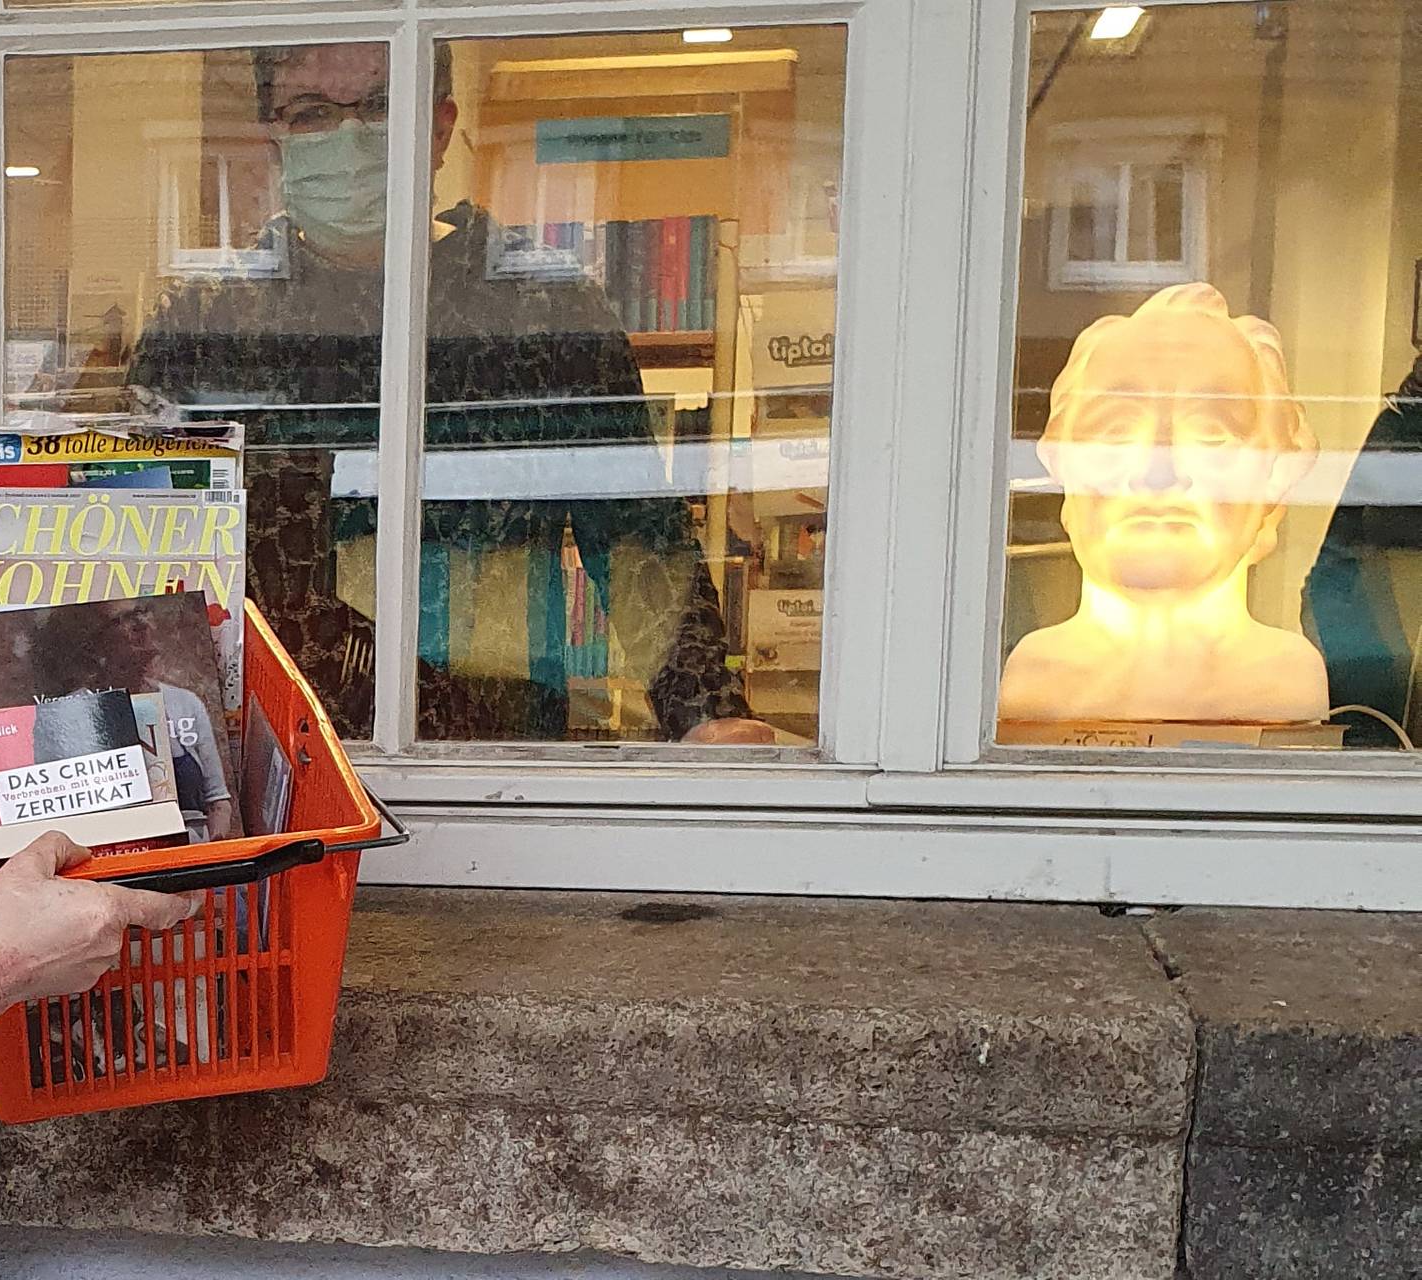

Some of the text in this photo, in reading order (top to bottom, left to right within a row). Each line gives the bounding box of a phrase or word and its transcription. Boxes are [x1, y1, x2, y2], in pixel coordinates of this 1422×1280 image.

[27, 435, 60, 455] 38
[65, 431, 107, 454] tolle
[2, 768, 140, 801] Verbrechen mit Qualität
[8, 753, 129, 790] DAS CRIME
[15, 782, 133, 820] ZERTIFIKAT
